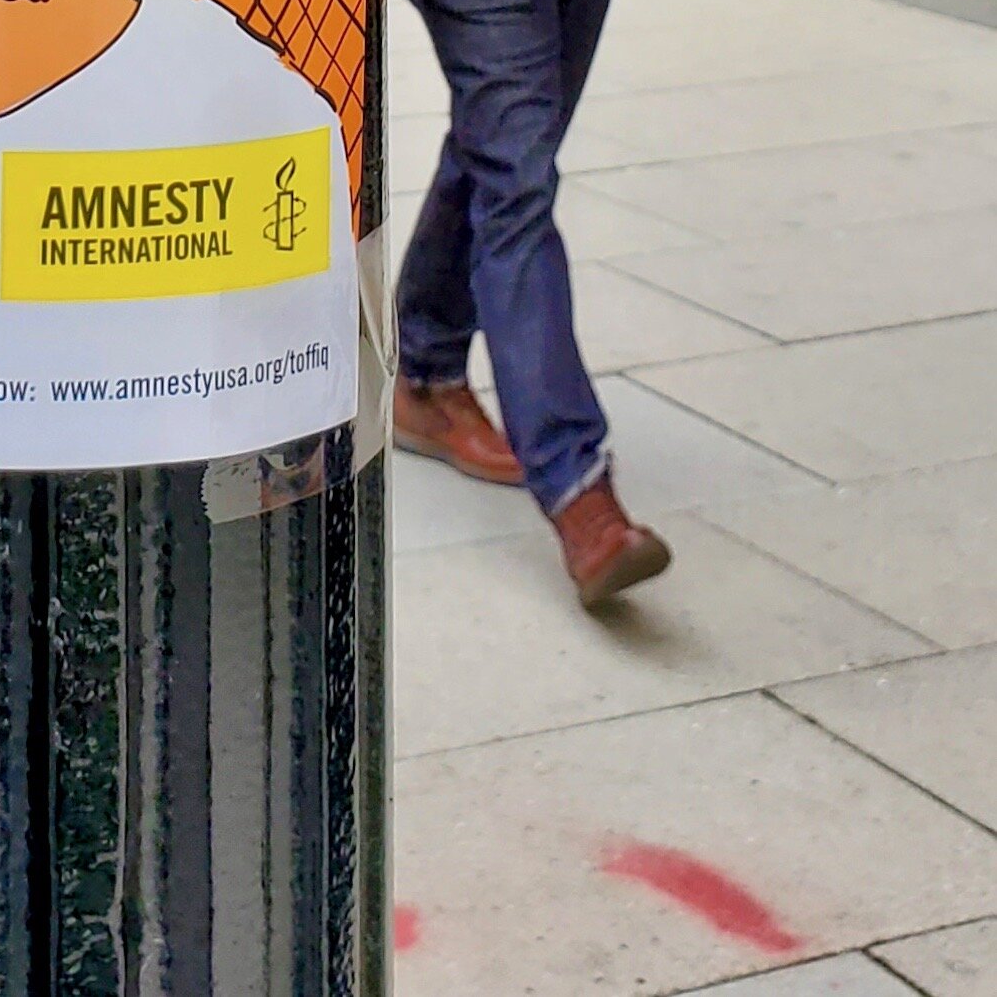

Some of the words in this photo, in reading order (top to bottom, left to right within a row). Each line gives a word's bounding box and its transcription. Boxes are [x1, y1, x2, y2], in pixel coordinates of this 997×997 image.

[41, 177, 235, 230] AMNESTY
[41, 230, 234, 266] INTERNATIONAL
[51, 343, 329, 402] www.amnestyusa.org/toffiq
